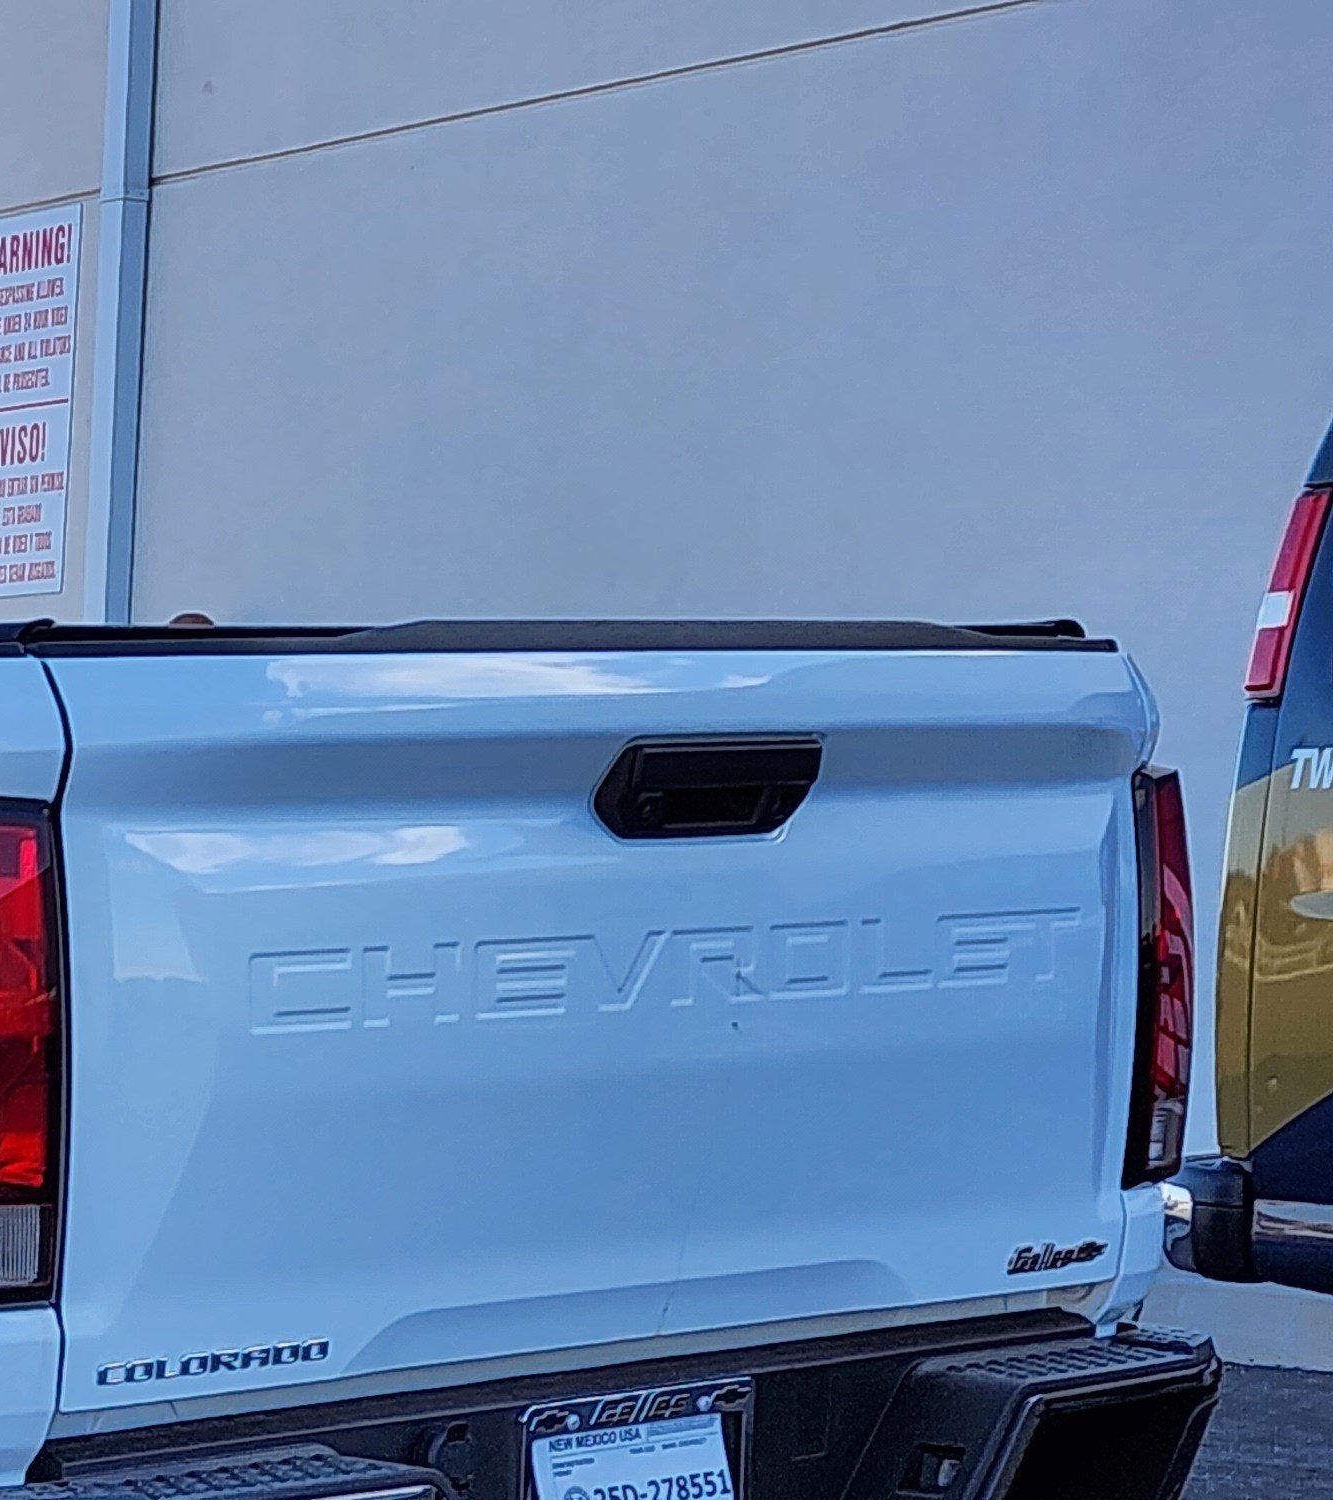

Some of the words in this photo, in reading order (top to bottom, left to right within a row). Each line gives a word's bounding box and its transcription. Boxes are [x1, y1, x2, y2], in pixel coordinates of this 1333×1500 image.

[248, 907, 1083, 1035] CHEVROLET
[96, 1337, 330, 1386] COLORADO
[548, 1437, 574, 1453] NEW
[576, 1431, 618, 1449] MEXICO
[619, 1427, 643, 1442] USA
